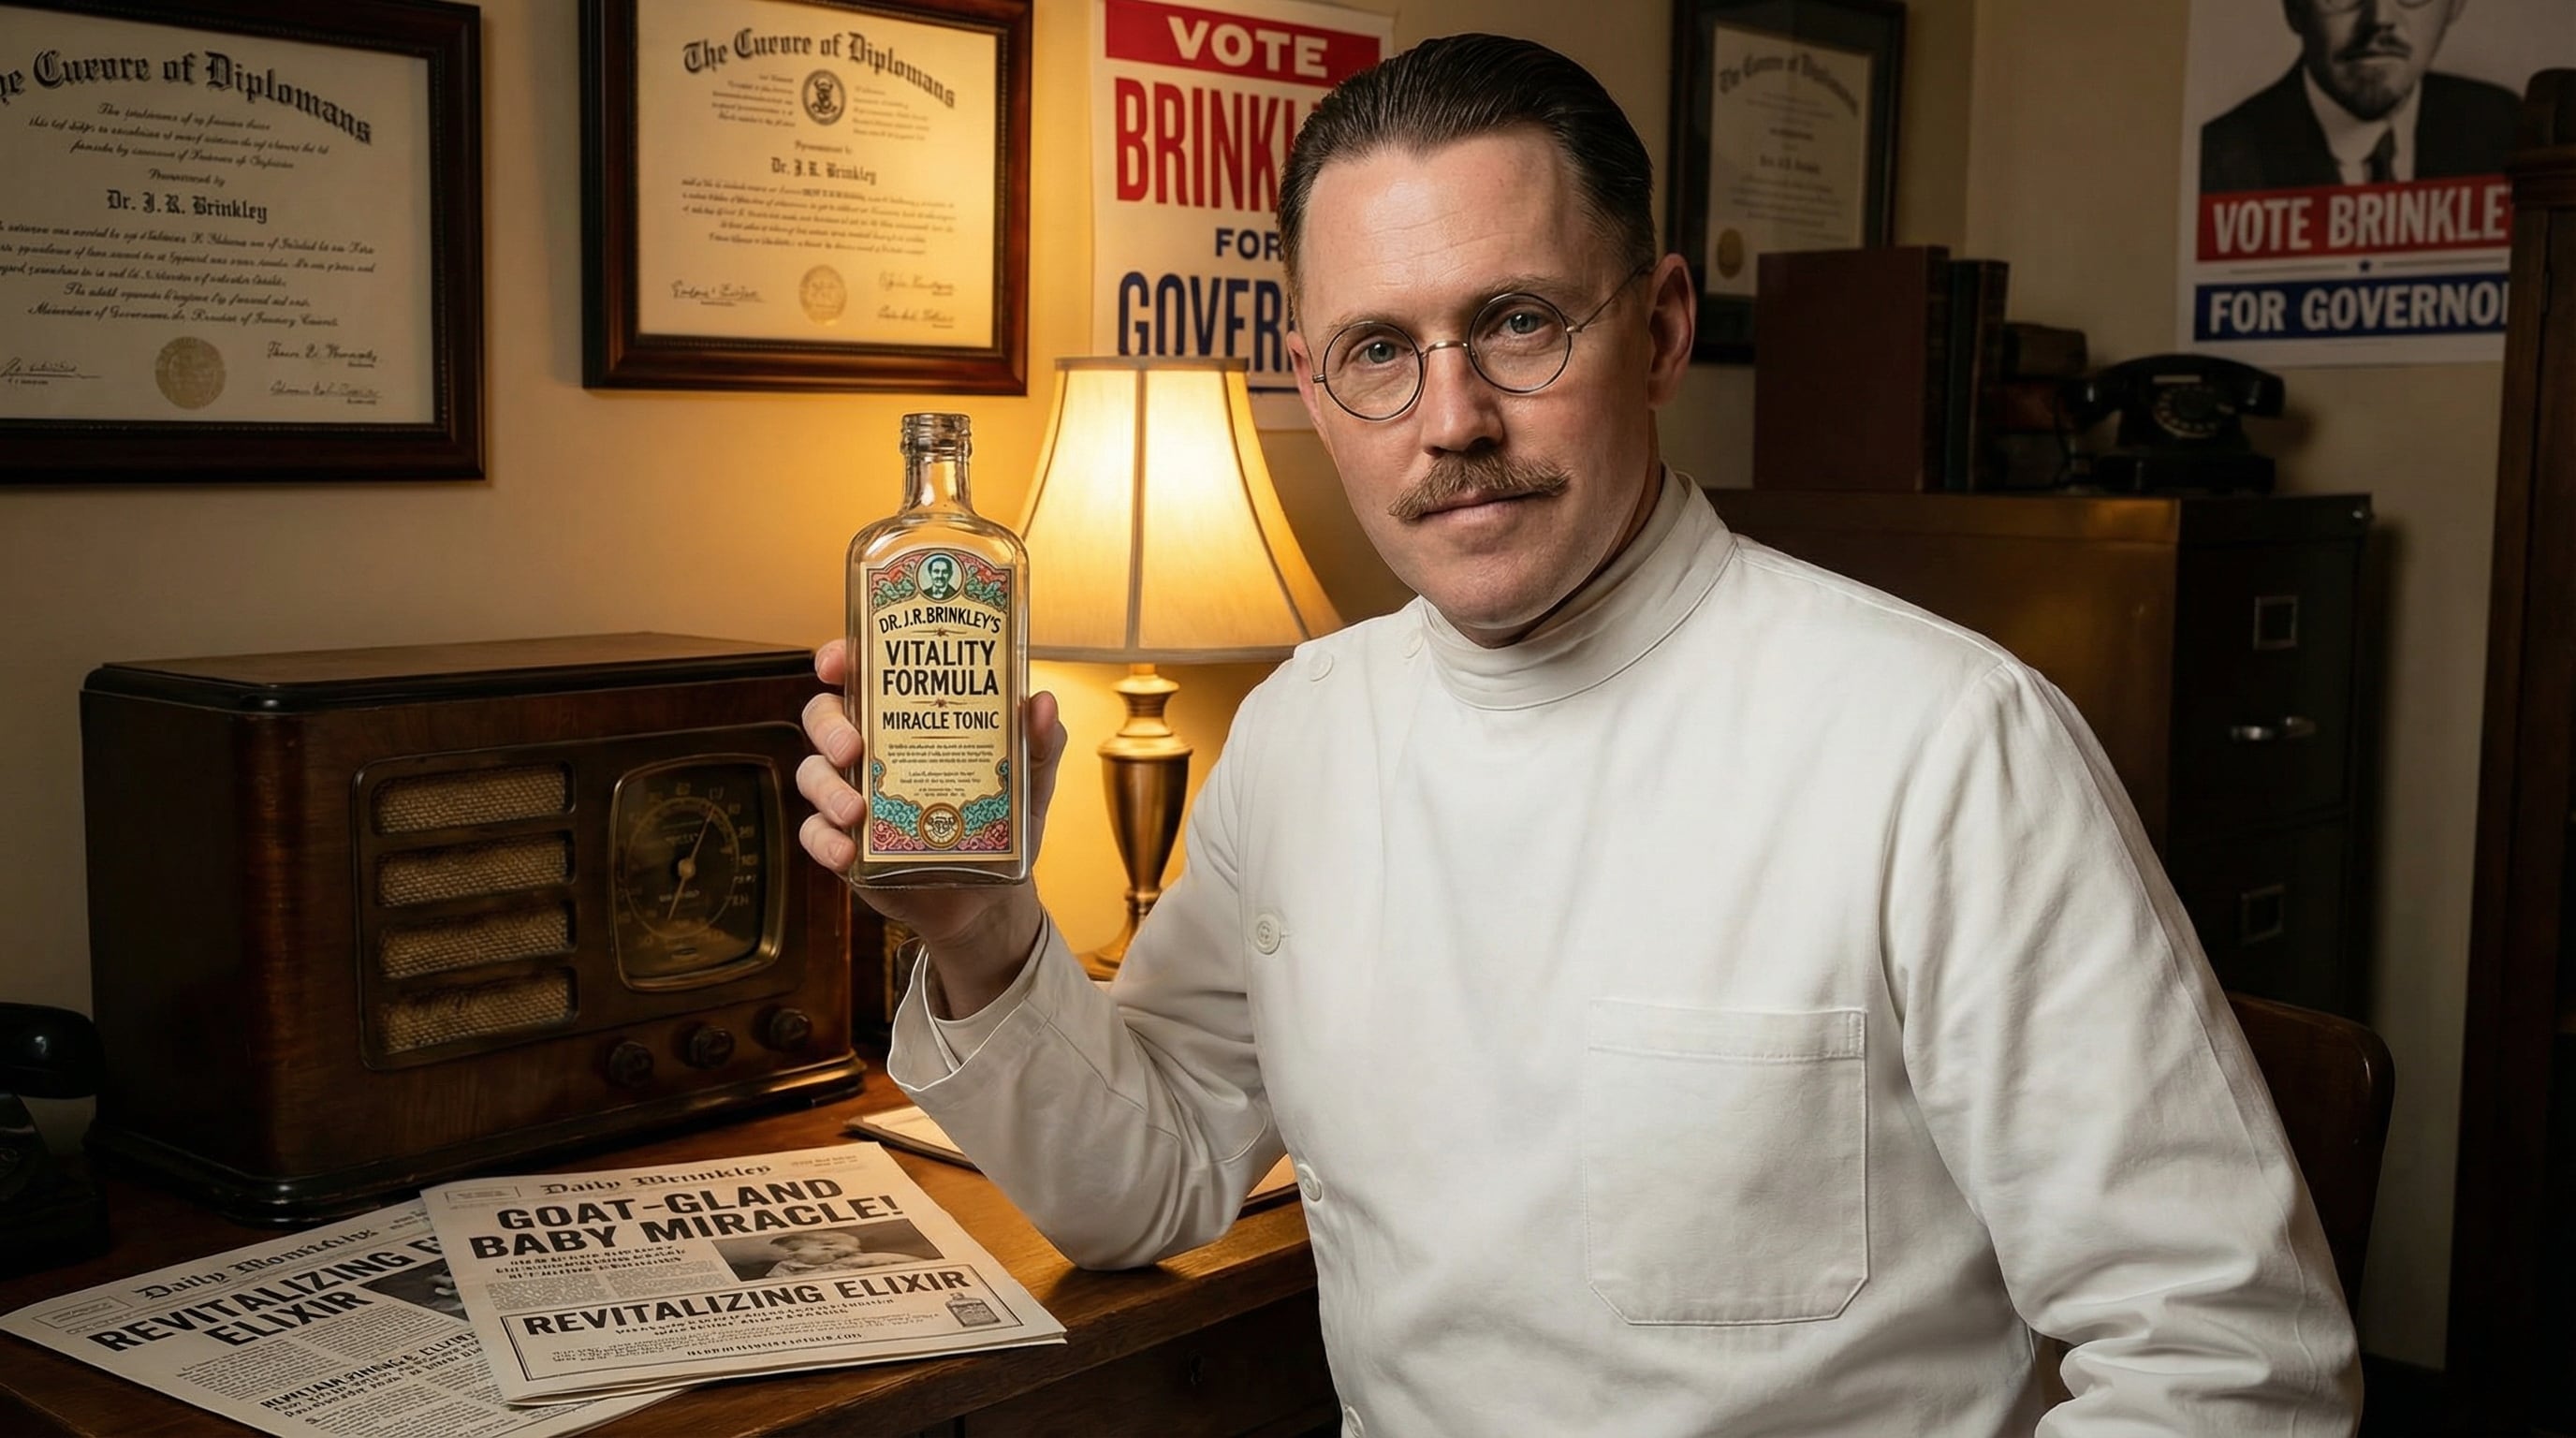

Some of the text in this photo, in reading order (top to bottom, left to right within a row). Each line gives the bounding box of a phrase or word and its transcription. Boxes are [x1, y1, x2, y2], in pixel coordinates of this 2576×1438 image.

[682, 38, 728, 74] The
[820, 32, 842, 57] of
[848, 31, 956, 109] Diplomans
[1168, 17, 1328, 78] VOTE
[163, 52, 196, 84] of
[205, 51, 372, 145] Diplomans
[1115, 77, 1320, 213] BRINK
[107, 189, 268, 225] Dr. J. R. Brinkley
[2213, 184, 2512, 254] VOTE BRINKLE
[1215, 227, 1284, 262] FOR
[1118, 271, 1294, 373] GOVER
[2210, 290, 2287, 333] FOR
[879, 614, 902, 634] DR.
[886, 639, 996, 666] VITALITY
[883, 669, 999, 696] FORMULA
[883, 712, 1000, 729] MIRACLE TONIC
[497, 1179, 843, 1230] GOAT-GLAND
[540, 1178, 622, 1196] Daily
[469, 1225, 617, 1259] BABY
[640, 1195, 904, 1243] MIRACLE!
[87, 1250, 418, 1352] REVITALIZING
[134, 1270, 231, 1300] Daily
[522, 1284, 827, 1336] REVITALIZING
[834, 1270, 972, 1299] ELIXIR
[202, 1283, 374, 1346] ELIXIR
